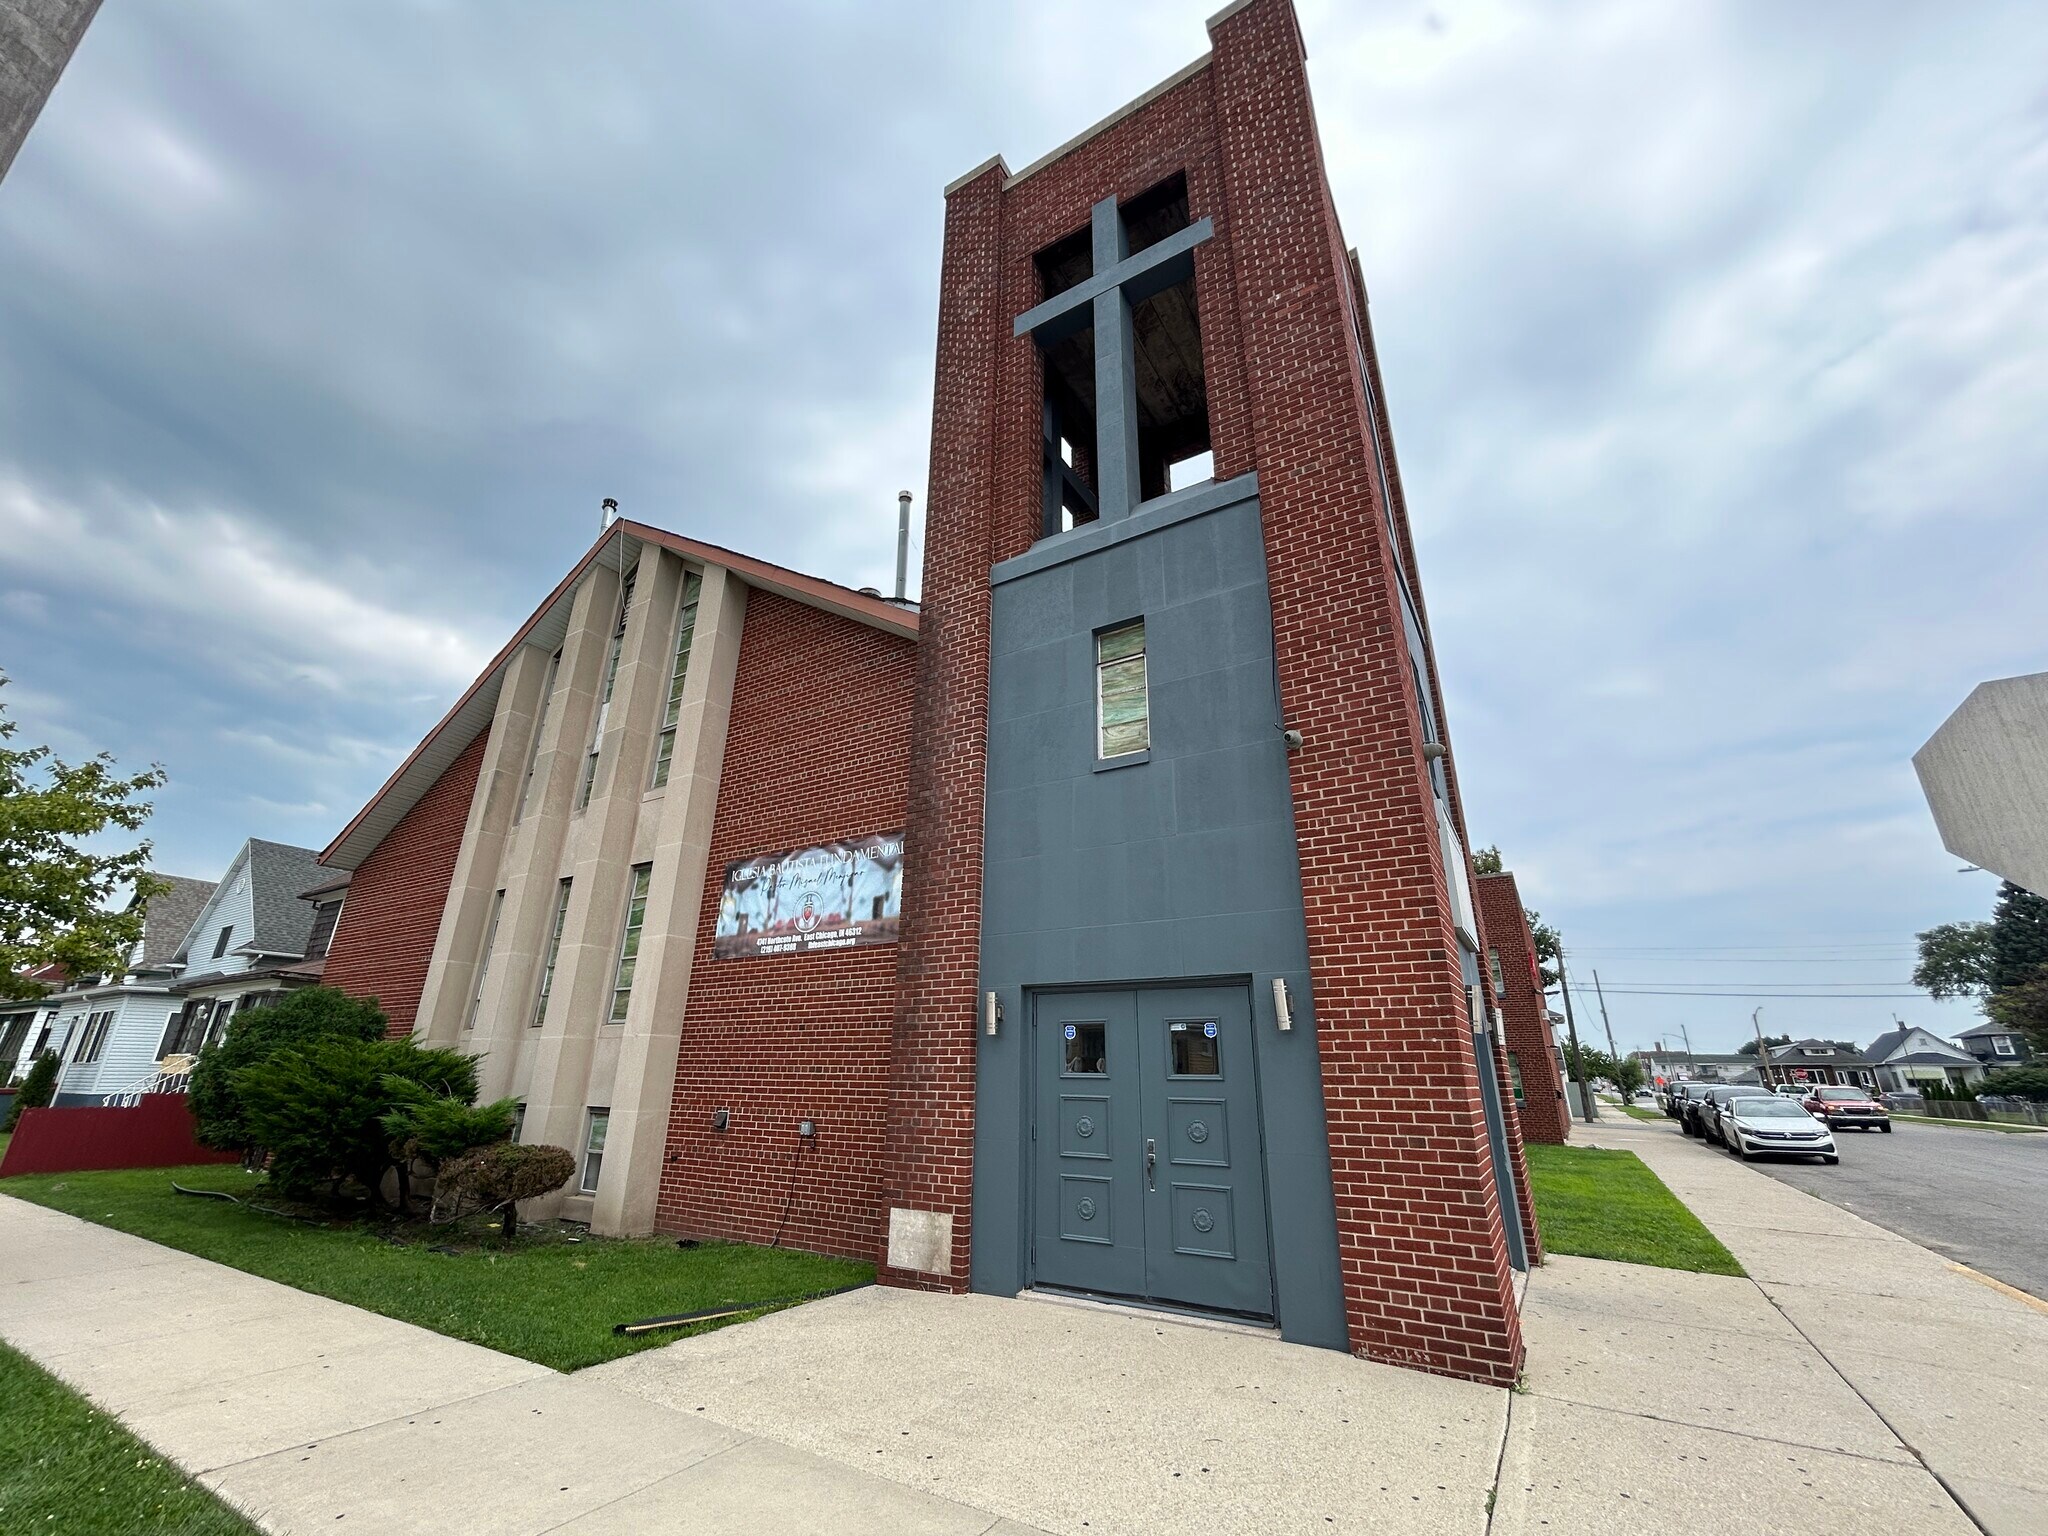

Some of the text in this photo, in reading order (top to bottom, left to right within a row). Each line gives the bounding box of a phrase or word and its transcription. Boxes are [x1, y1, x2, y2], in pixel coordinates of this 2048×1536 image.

[731, 865, 766, 882] IGLESIA
[769, 857, 816, 877] BAUTISTA
[804, 933, 815, 941] East
